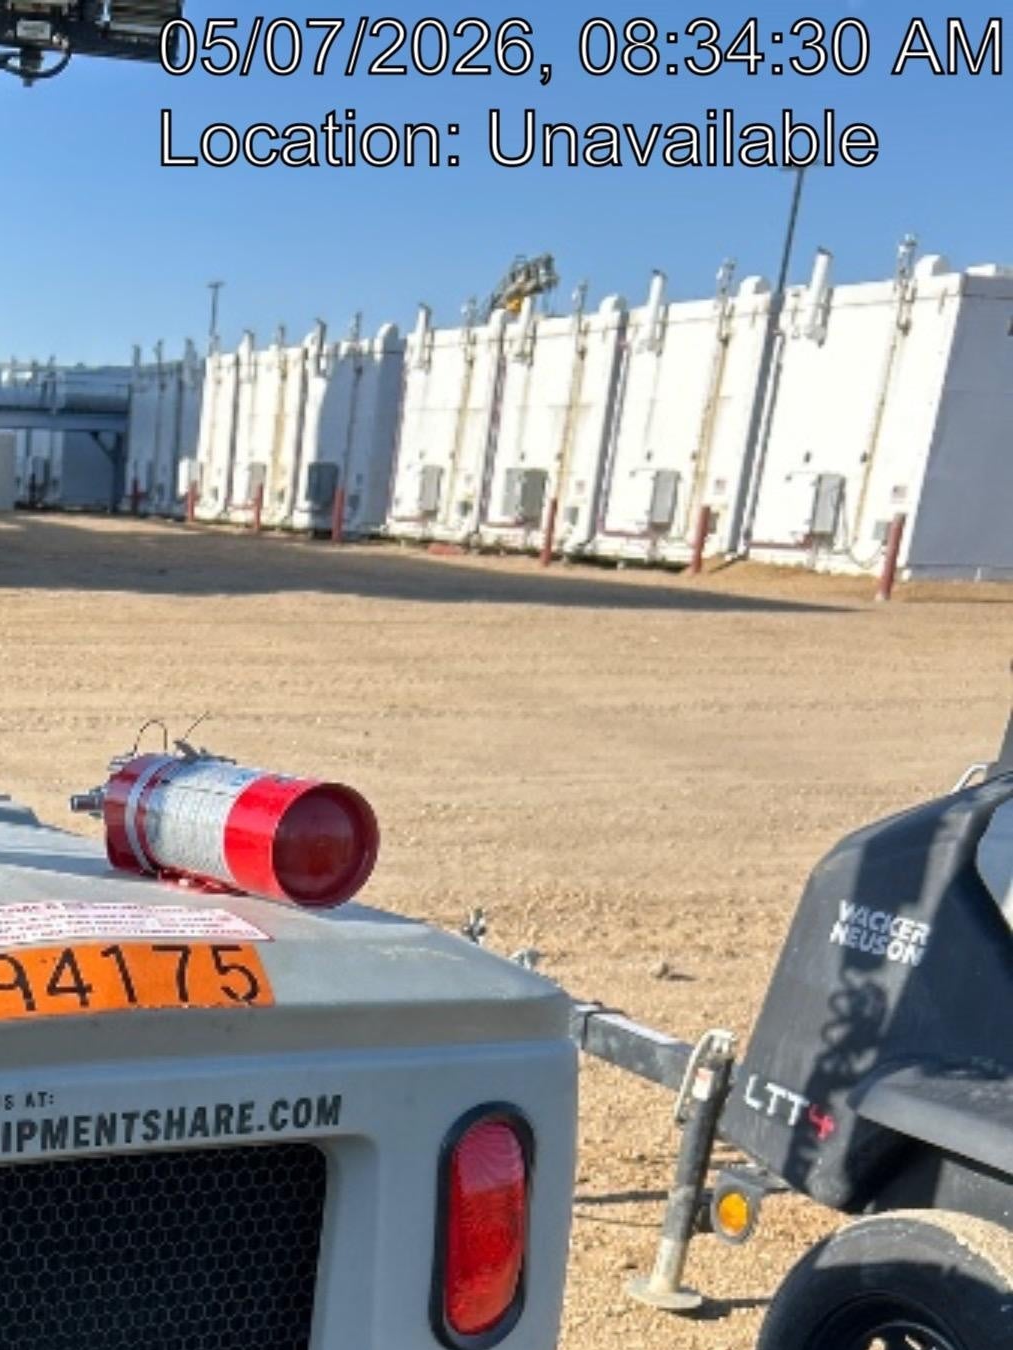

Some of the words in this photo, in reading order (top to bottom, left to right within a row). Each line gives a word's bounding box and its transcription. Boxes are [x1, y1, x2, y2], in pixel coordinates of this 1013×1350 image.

[829, 921, 925, 967] NEUSON
[839, 900, 931, 946] WACKER
[25, 1091, 55, 1108] AT:
